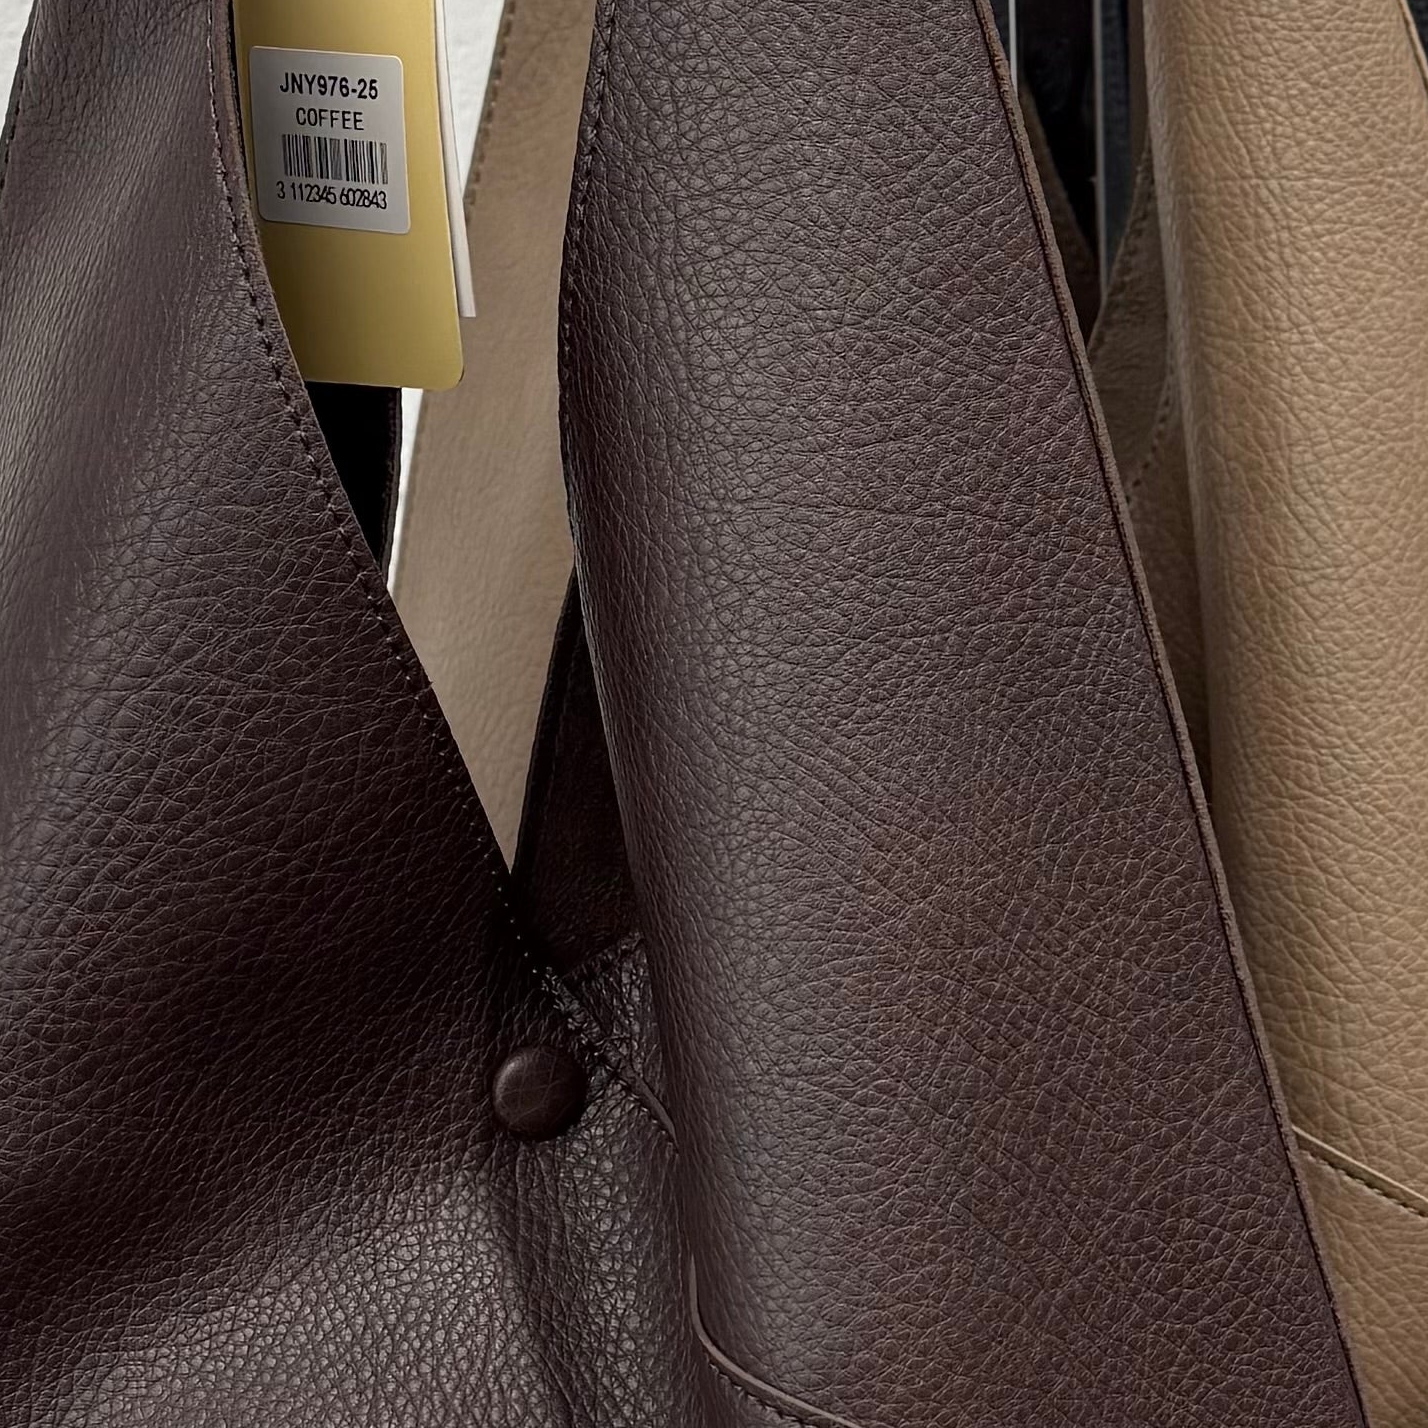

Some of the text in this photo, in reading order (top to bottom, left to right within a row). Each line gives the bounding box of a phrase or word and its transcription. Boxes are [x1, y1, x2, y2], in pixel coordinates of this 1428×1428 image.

[279, 72, 379, 100] JNY976-25
[295, 107, 365, 131] COFFEE
[276, 180, 286, 200] 3
